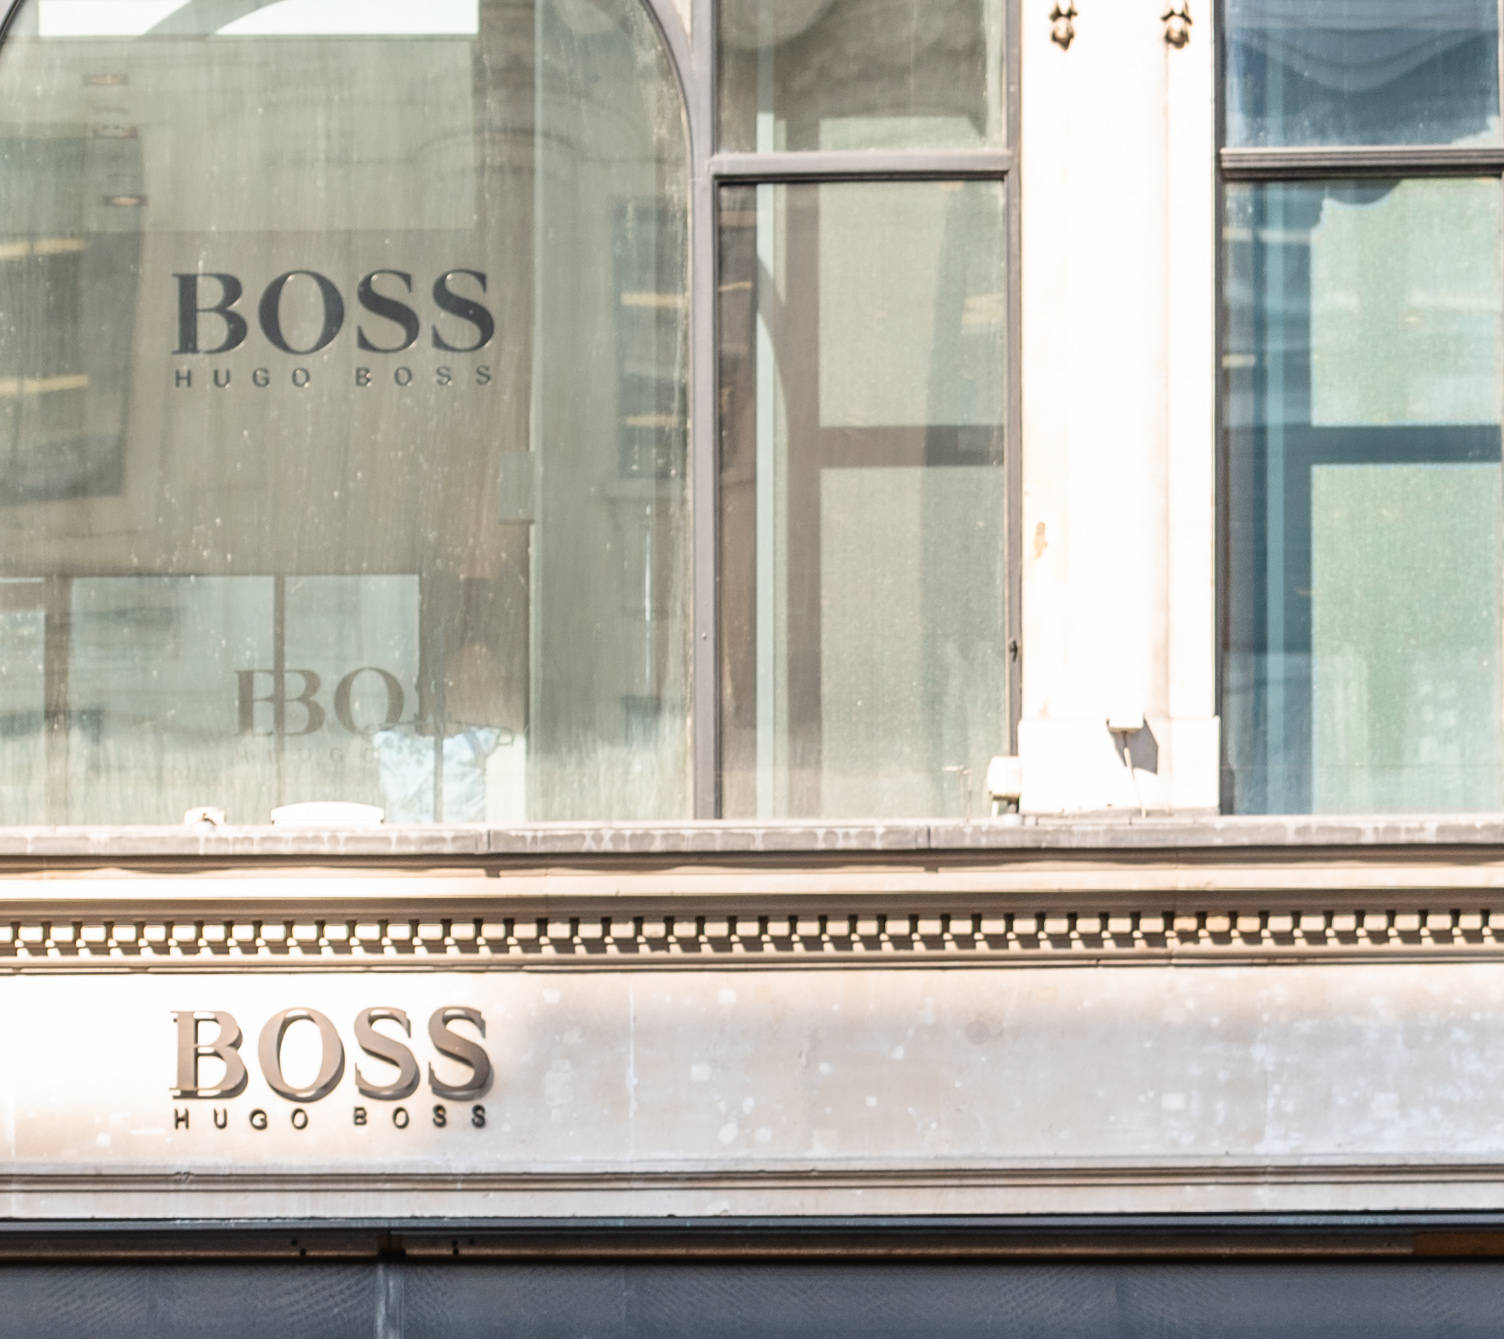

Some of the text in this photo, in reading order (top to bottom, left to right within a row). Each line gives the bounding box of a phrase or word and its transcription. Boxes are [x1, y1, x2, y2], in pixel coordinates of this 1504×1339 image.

[171, 269, 495, 355] BOSS
[175, 365, 492, 388] HUGO BOSS
[169, 1006, 495, 1101] BOSS
[174, 1105, 487, 1130] HUGO BOSS
